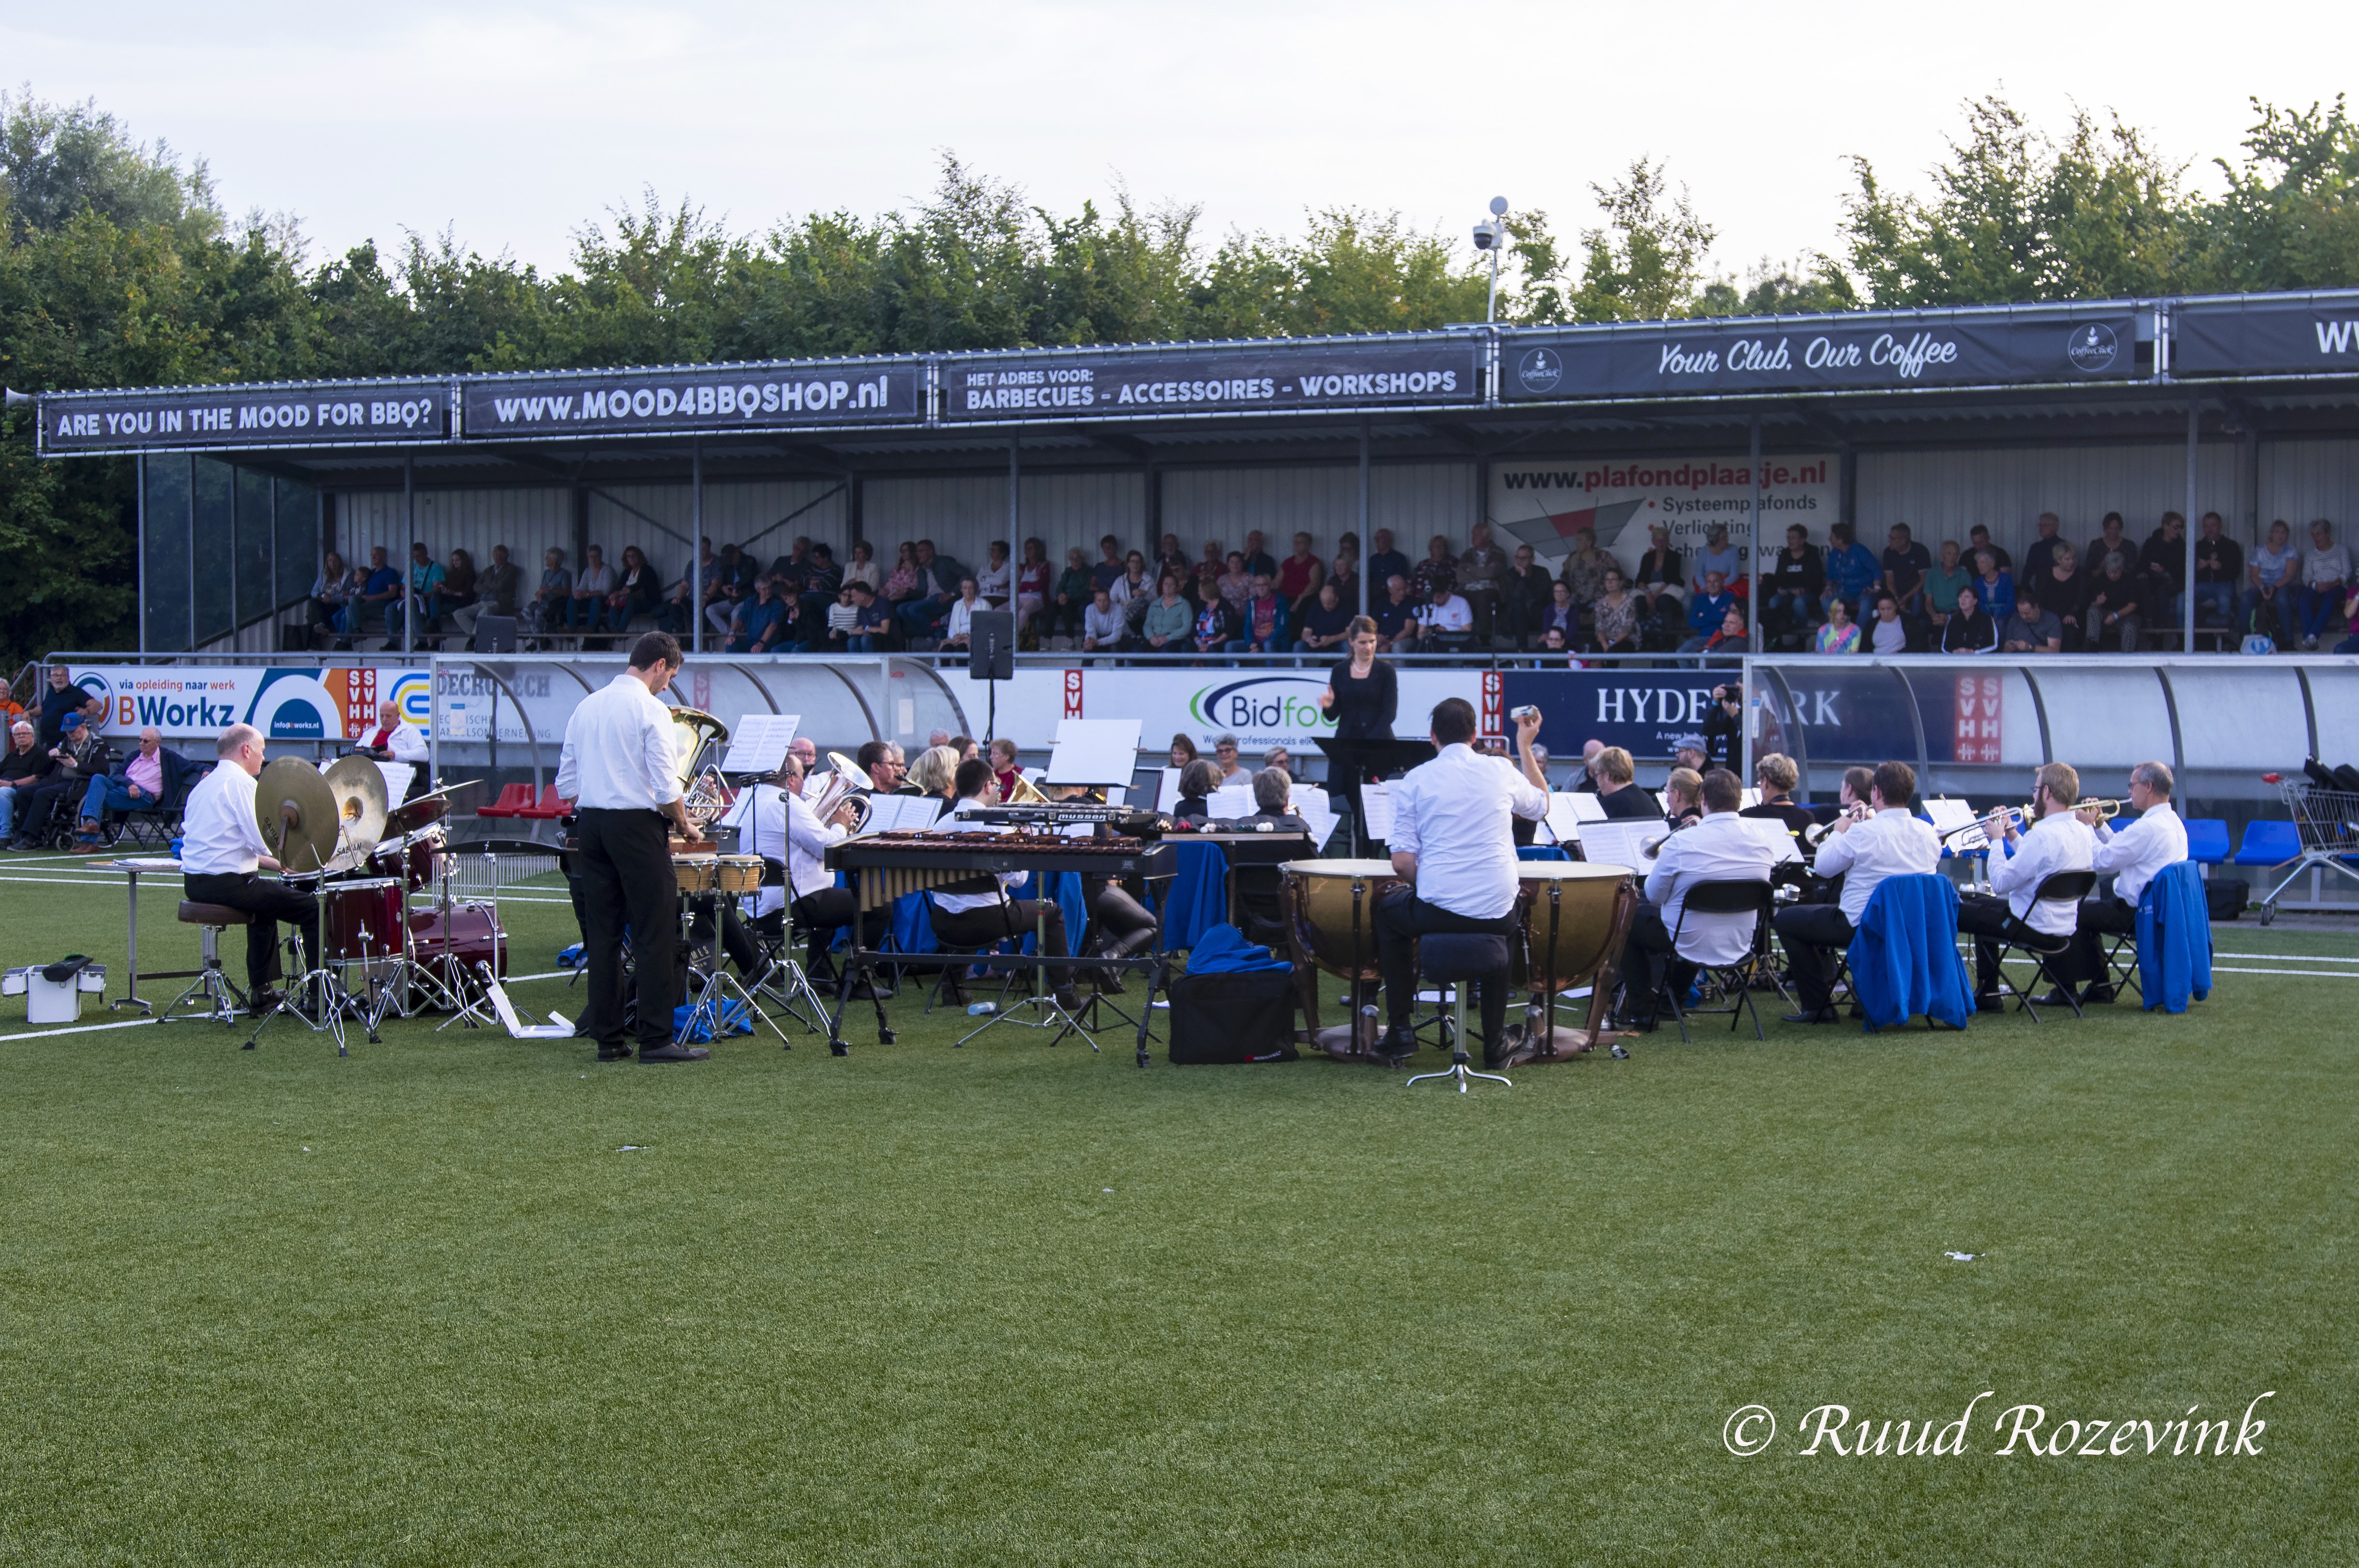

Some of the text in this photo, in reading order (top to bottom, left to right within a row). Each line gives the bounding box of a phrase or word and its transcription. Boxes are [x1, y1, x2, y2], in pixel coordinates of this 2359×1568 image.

[2315, 321, 2359, 353] W
[1659, 332, 1958, 378] Your Club, Our Coffee
[968, 369, 1094, 387] HET ADRES VOOR:
[968, 386, 1094, 410] BARBECUES
[1118, 378, 1274, 404] ACCESSOIRES
[1300, 370, 1457, 397] WORKSHOPS
[58, 398, 432, 436] ARE YOU IN THE MOOD FOR BBQ?
[1663, 494, 1817, 514] Systeempafonds
[1663, 519, 1751, 536] Verlictin
[119, 679, 235, 693] via opleiding naar werk
[119, 696, 235, 726] BWorkz
[1232, 696, 1341, 727] Bidfo
[1597, 688, 1841, 726] HYDE ARK
[1237, 735, 1296, 745] rofessionals
[1656, 731, 1663, 740] A
[264, 817, 279, 845] SABIA
[337, 842, 362, 854] SABAN
